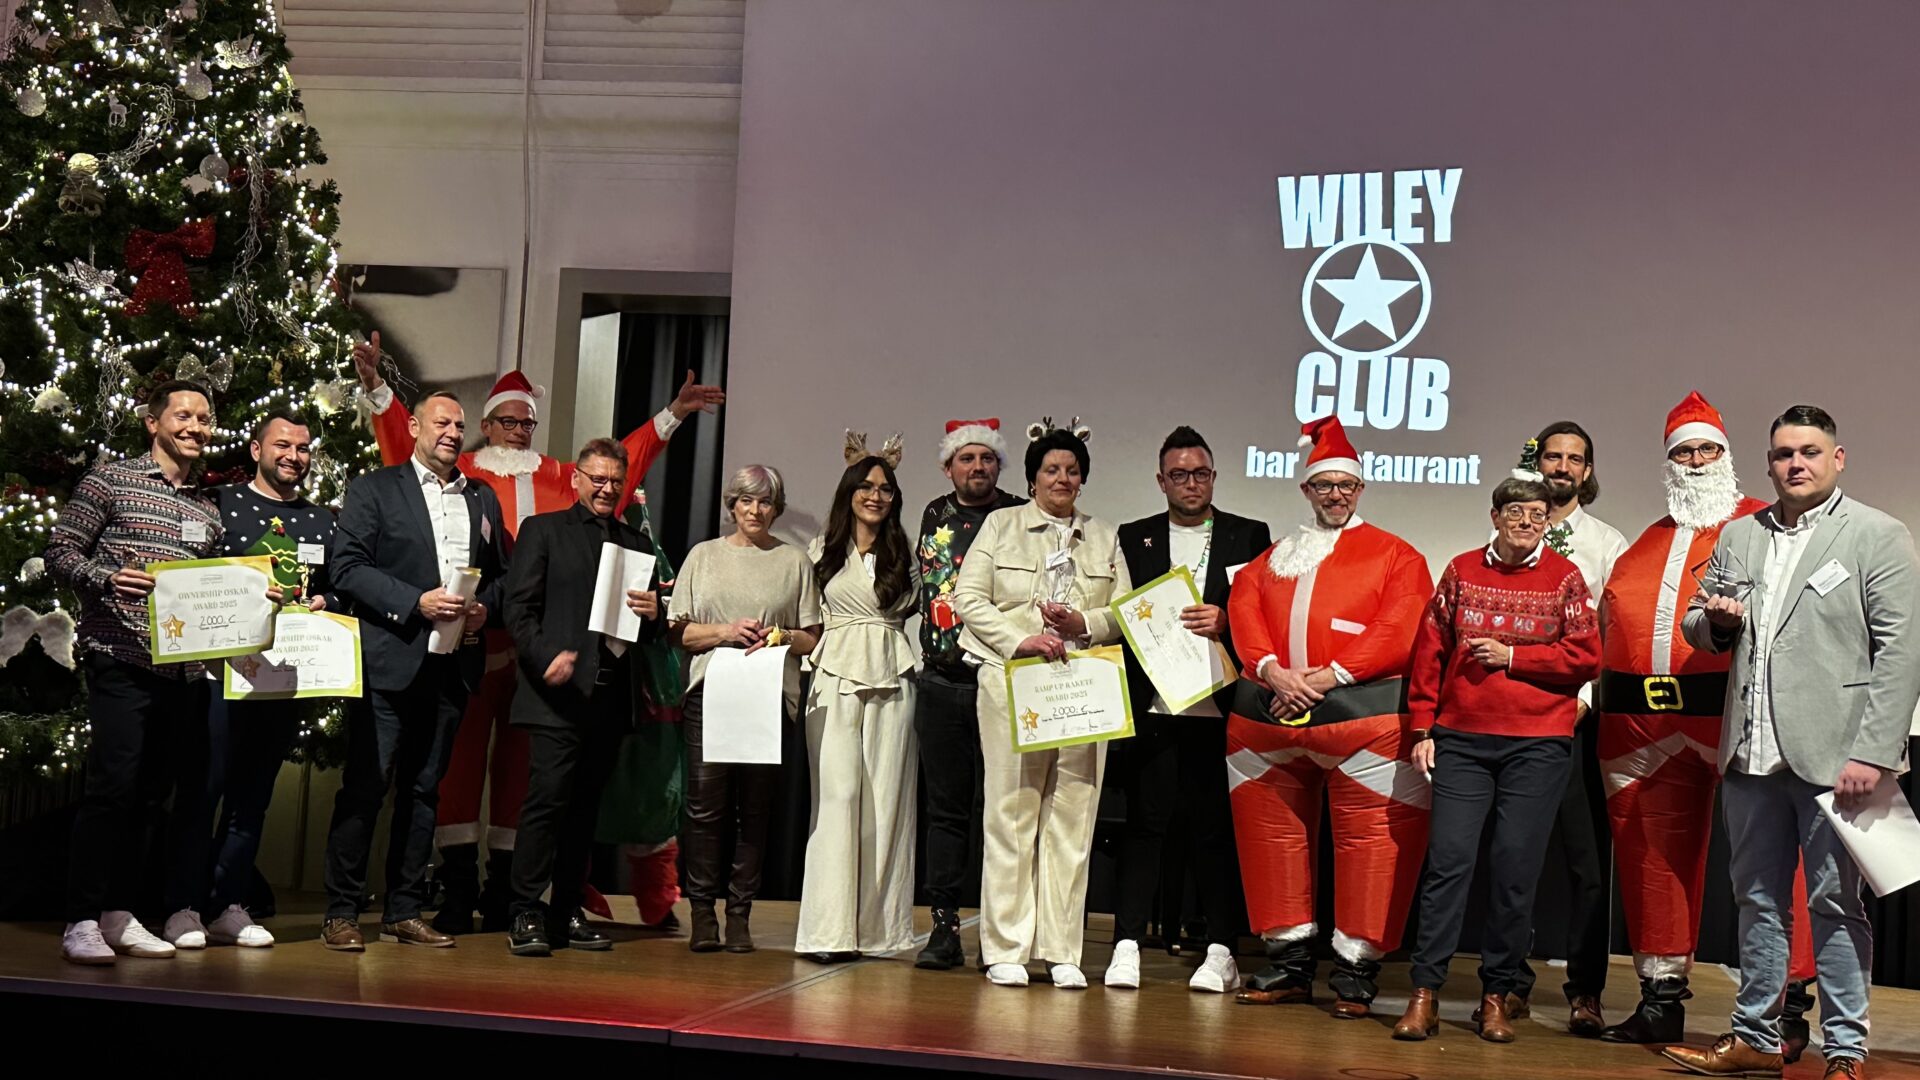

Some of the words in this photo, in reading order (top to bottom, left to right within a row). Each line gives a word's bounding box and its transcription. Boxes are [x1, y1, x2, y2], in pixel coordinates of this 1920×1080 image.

[1277, 168, 1463, 249] WILEY
[1294, 351, 1450, 431] CLUB
[1246, 445, 1300, 478] bar
[1357, 450, 1480, 485] taurant
[178, 589, 223, 600] OWNERSHIP
[223, 587, 249, 596] OSKAR
[193, 601, 218, 611] AWARD
[1565, 602, 1582, 620] HO
[1462, 609, 1485, 626] HO
